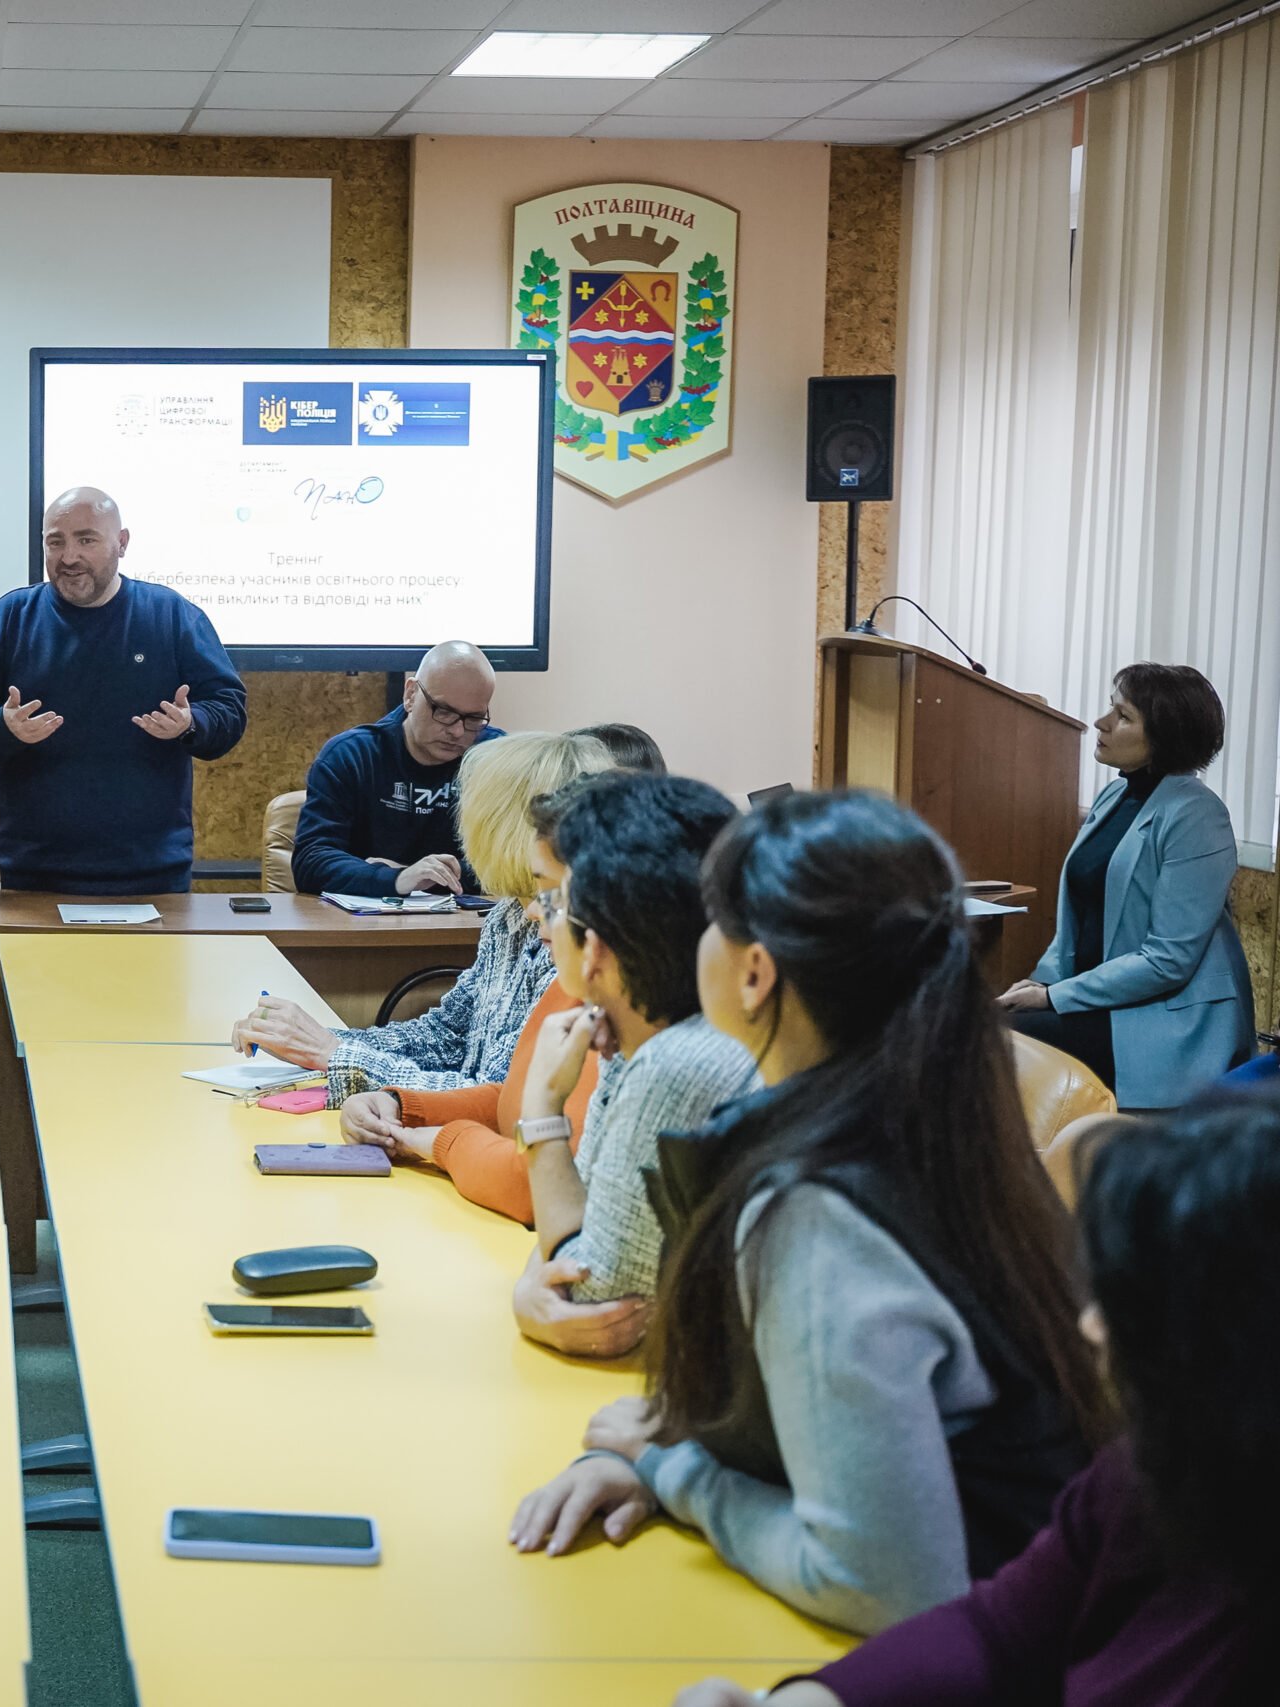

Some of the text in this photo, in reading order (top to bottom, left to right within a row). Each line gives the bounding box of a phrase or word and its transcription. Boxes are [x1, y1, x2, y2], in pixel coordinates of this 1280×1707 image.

[553, 198, 696, 230] ПОЛТАВЩИНА
[290, 401, 319, 410] КІБЕР
[267, 551, 324, 568] Тренінг
[240, 575, 311, 588] учасників
[316, 573, 395, 586] освітнього
[218, 594, 279, 605] виклики
[283, 594, 298, 605] та
[303, 594, 369, 607] відповіді
[374, 594, 392, 605] на
